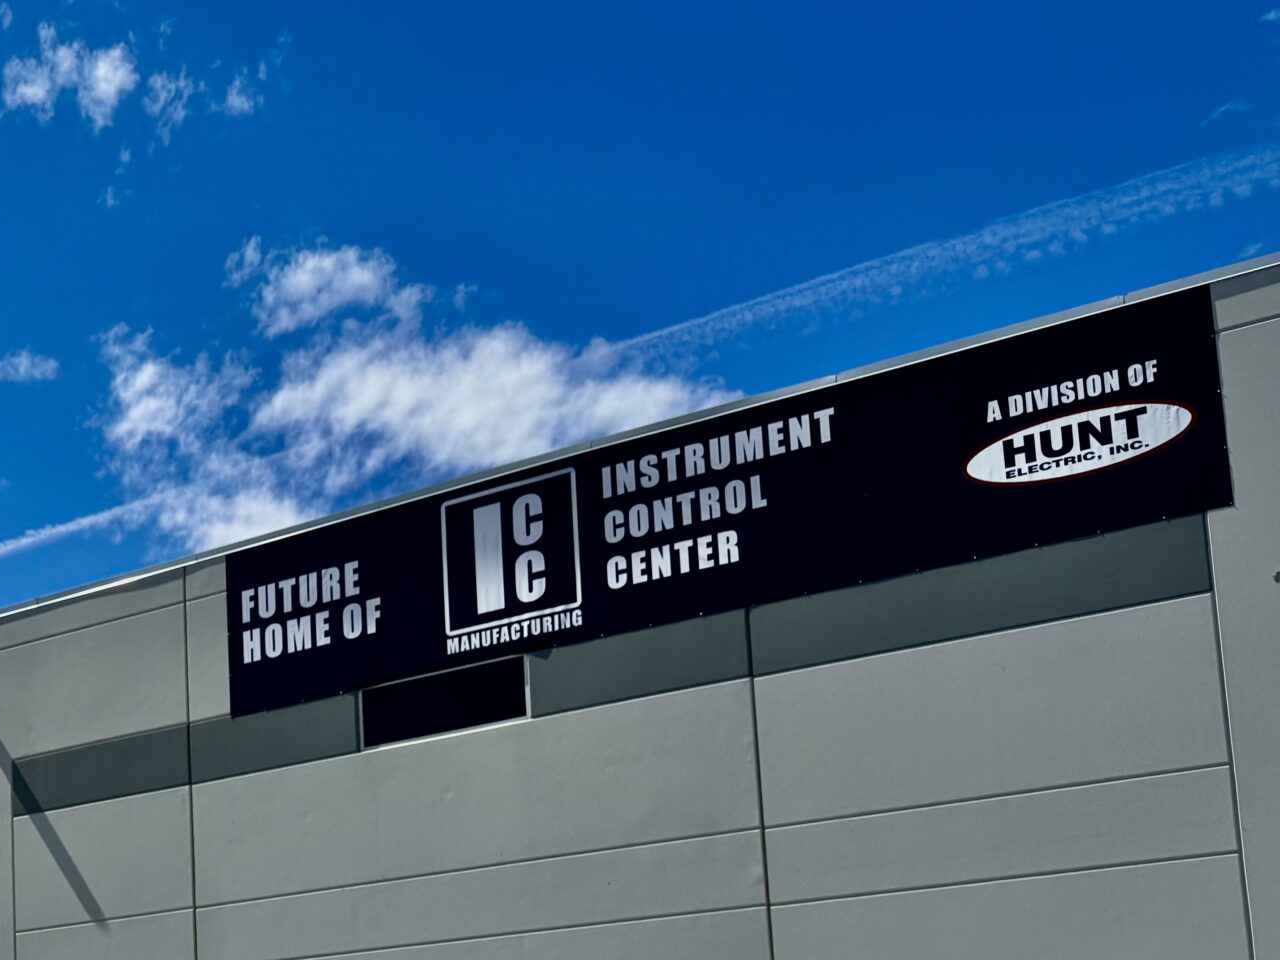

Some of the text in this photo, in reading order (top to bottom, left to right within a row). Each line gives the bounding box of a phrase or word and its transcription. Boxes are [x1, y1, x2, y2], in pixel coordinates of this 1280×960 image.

[986, 359, 1158, 423] A DIVISION OF
[602, 407, 835, 499] INSTRUMENT
[1002, 406, 1148, 468] HUNT
[1005, 440, 1150, 480] ELECTRIC, INC.
[604, 474, 767, 543] CONTROL
[606, 530, 740, 589] CENTER
[241, 560, 360, 623] FUTURE
[242, 597, 381, 664] HOME OF
[446, 609, 583, 655] MANUFACTURING
